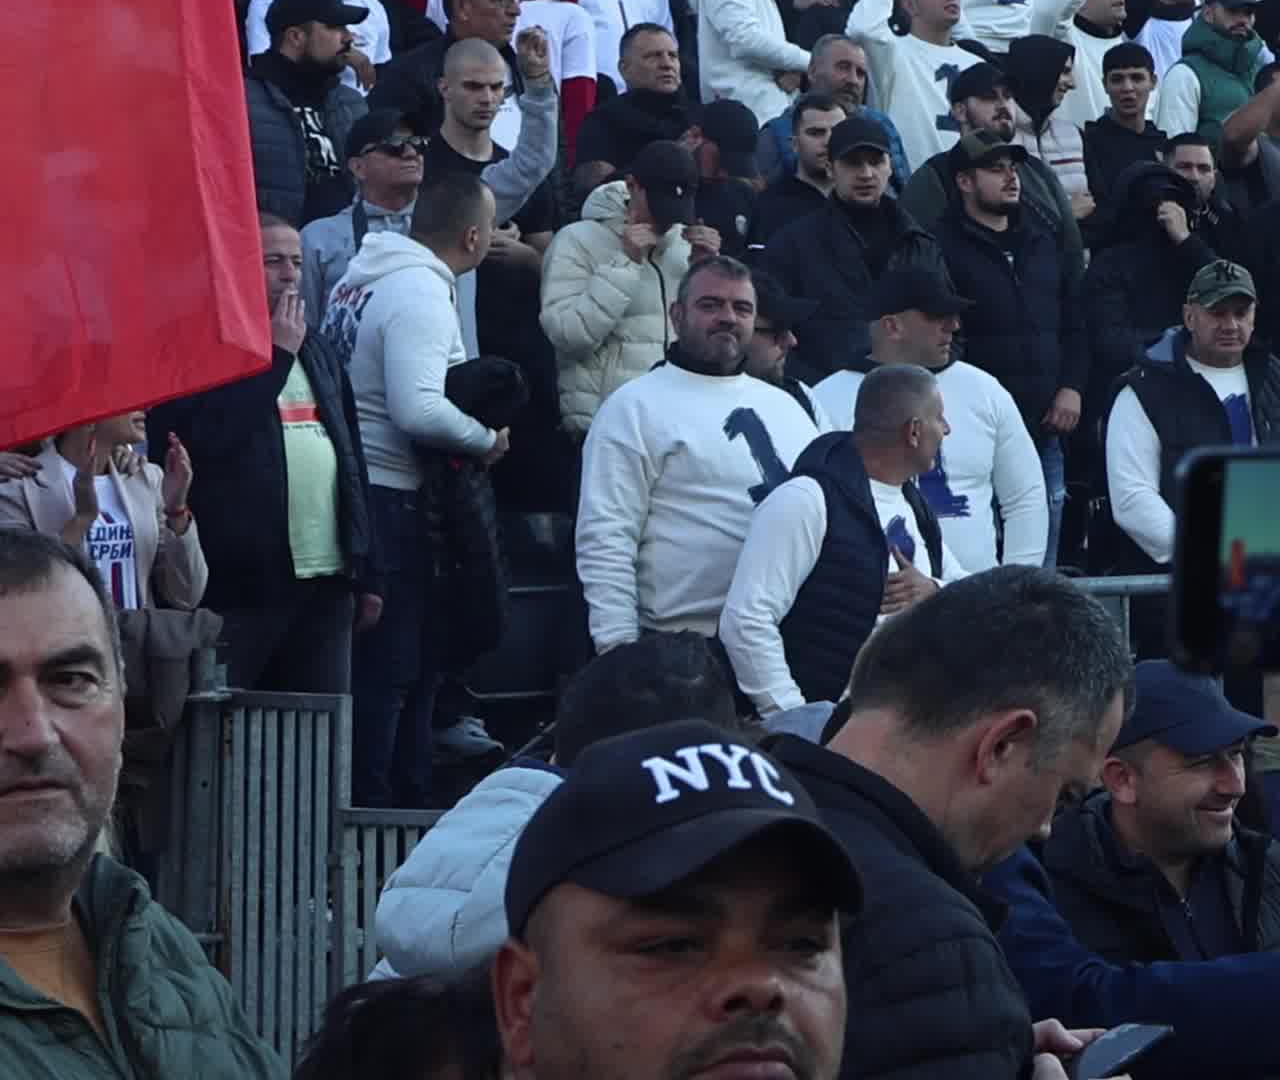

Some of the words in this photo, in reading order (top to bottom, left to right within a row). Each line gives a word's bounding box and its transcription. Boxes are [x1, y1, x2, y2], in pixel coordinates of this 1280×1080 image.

[722, 407, 790, 508] 1
[89, 541, 132, 560] СРБИ
[641, 743, 795, 805] NYC
